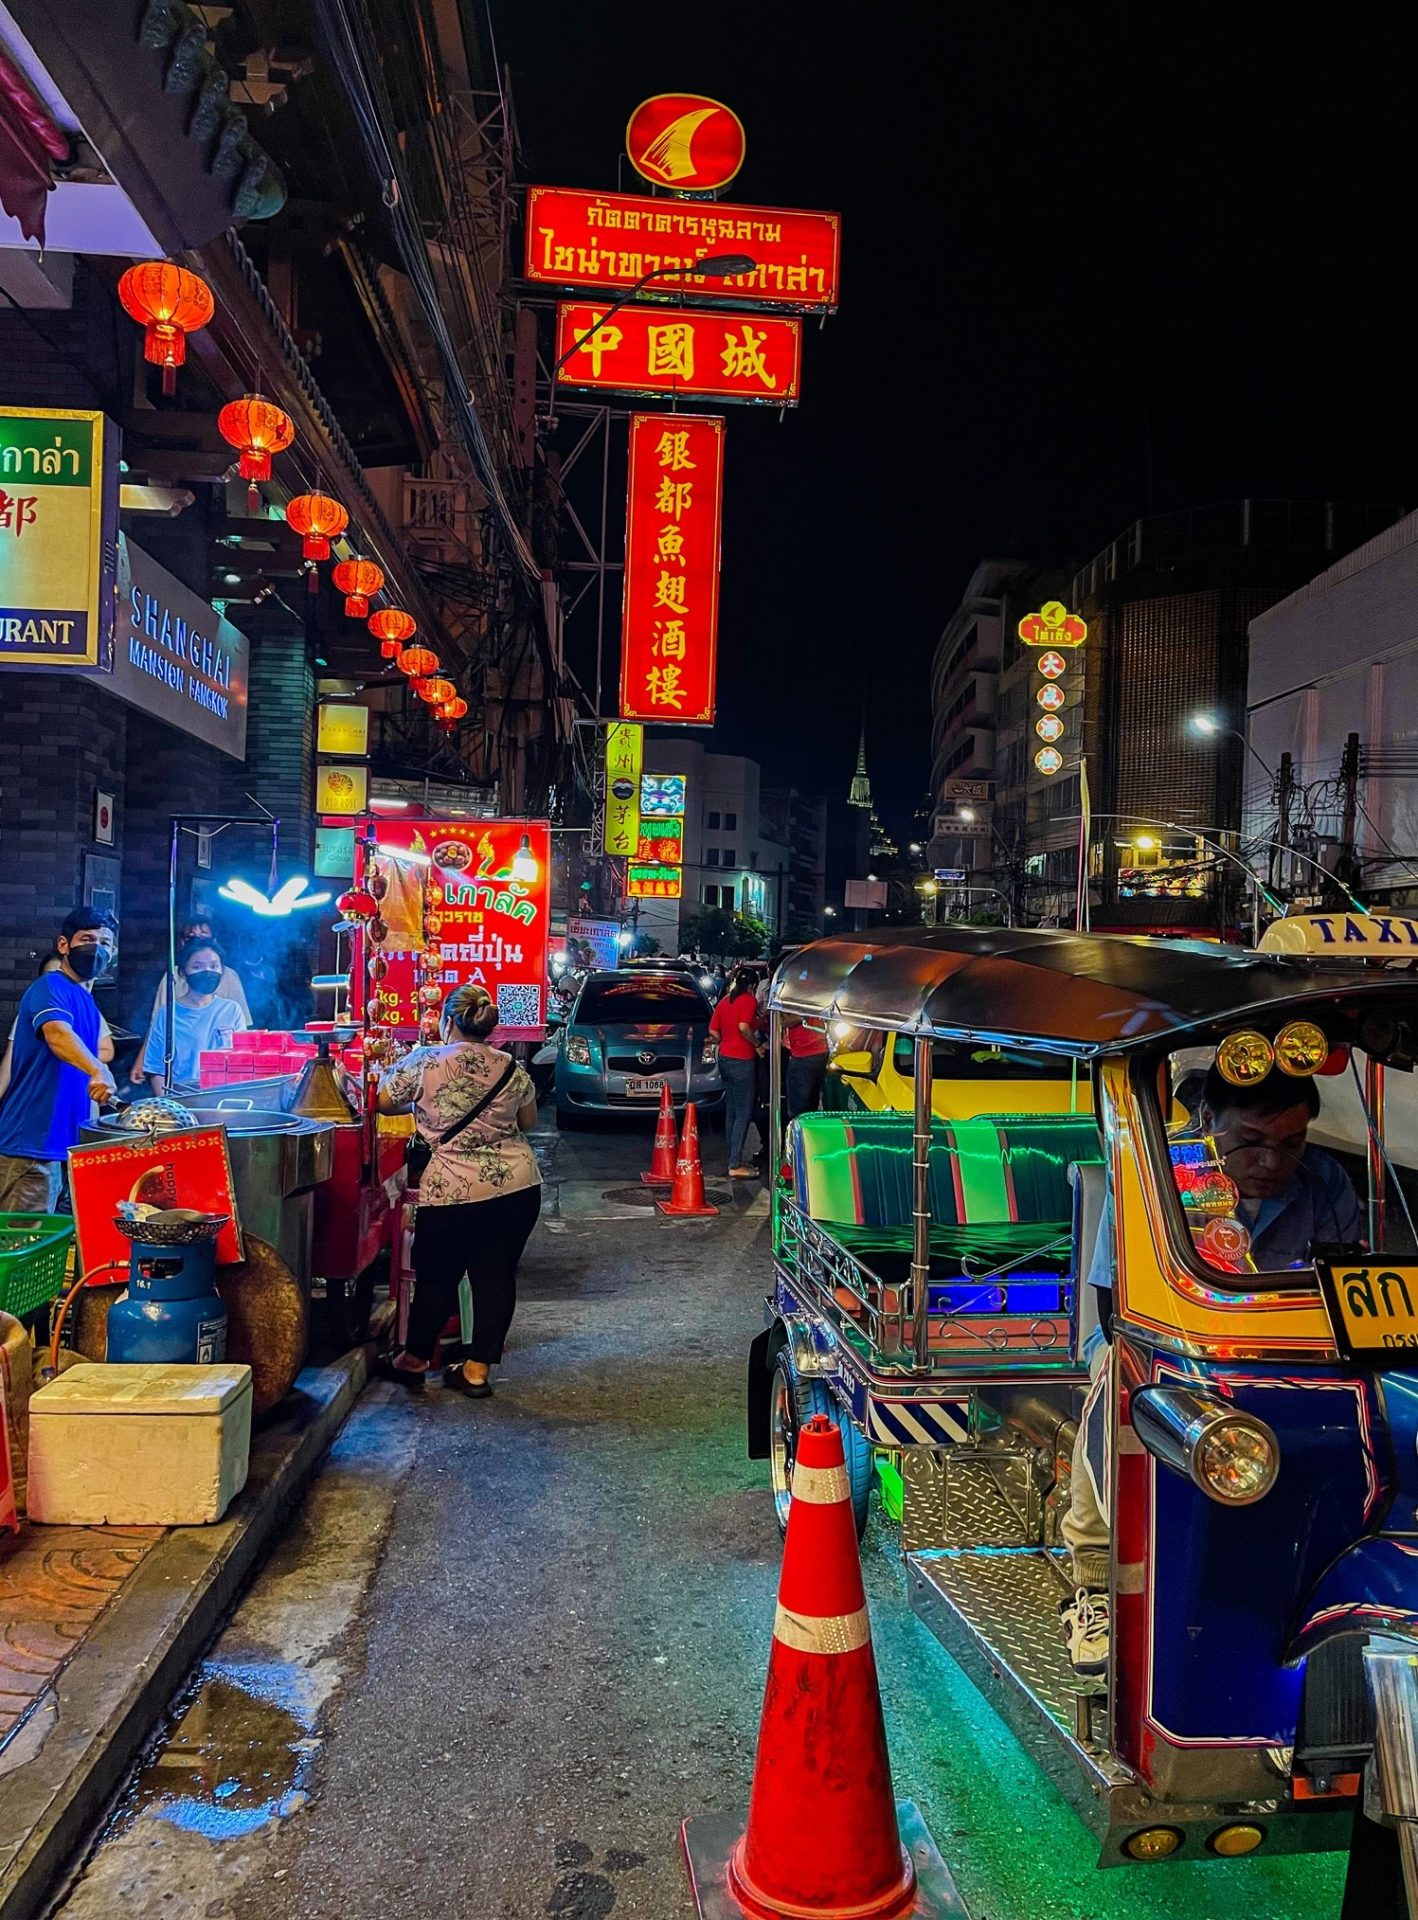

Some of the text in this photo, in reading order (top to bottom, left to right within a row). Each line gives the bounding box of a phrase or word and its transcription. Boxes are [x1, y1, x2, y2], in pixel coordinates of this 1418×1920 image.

[587, 199, 781, 244] ภัตตาคารหูฉลาม
[573, 312, 777, 389] 中國城
[645, 431, 697, 710] 銀都魚翅酒樓
[131, 586, 230, 690] SHANGHAI
[129, 637, 228, 720] MANSION BANGKOK
[328, 854, 351, 864] Group
[437, 910, 483, 924] าวราช
[1342, 1269, 1415, 1317] สก
